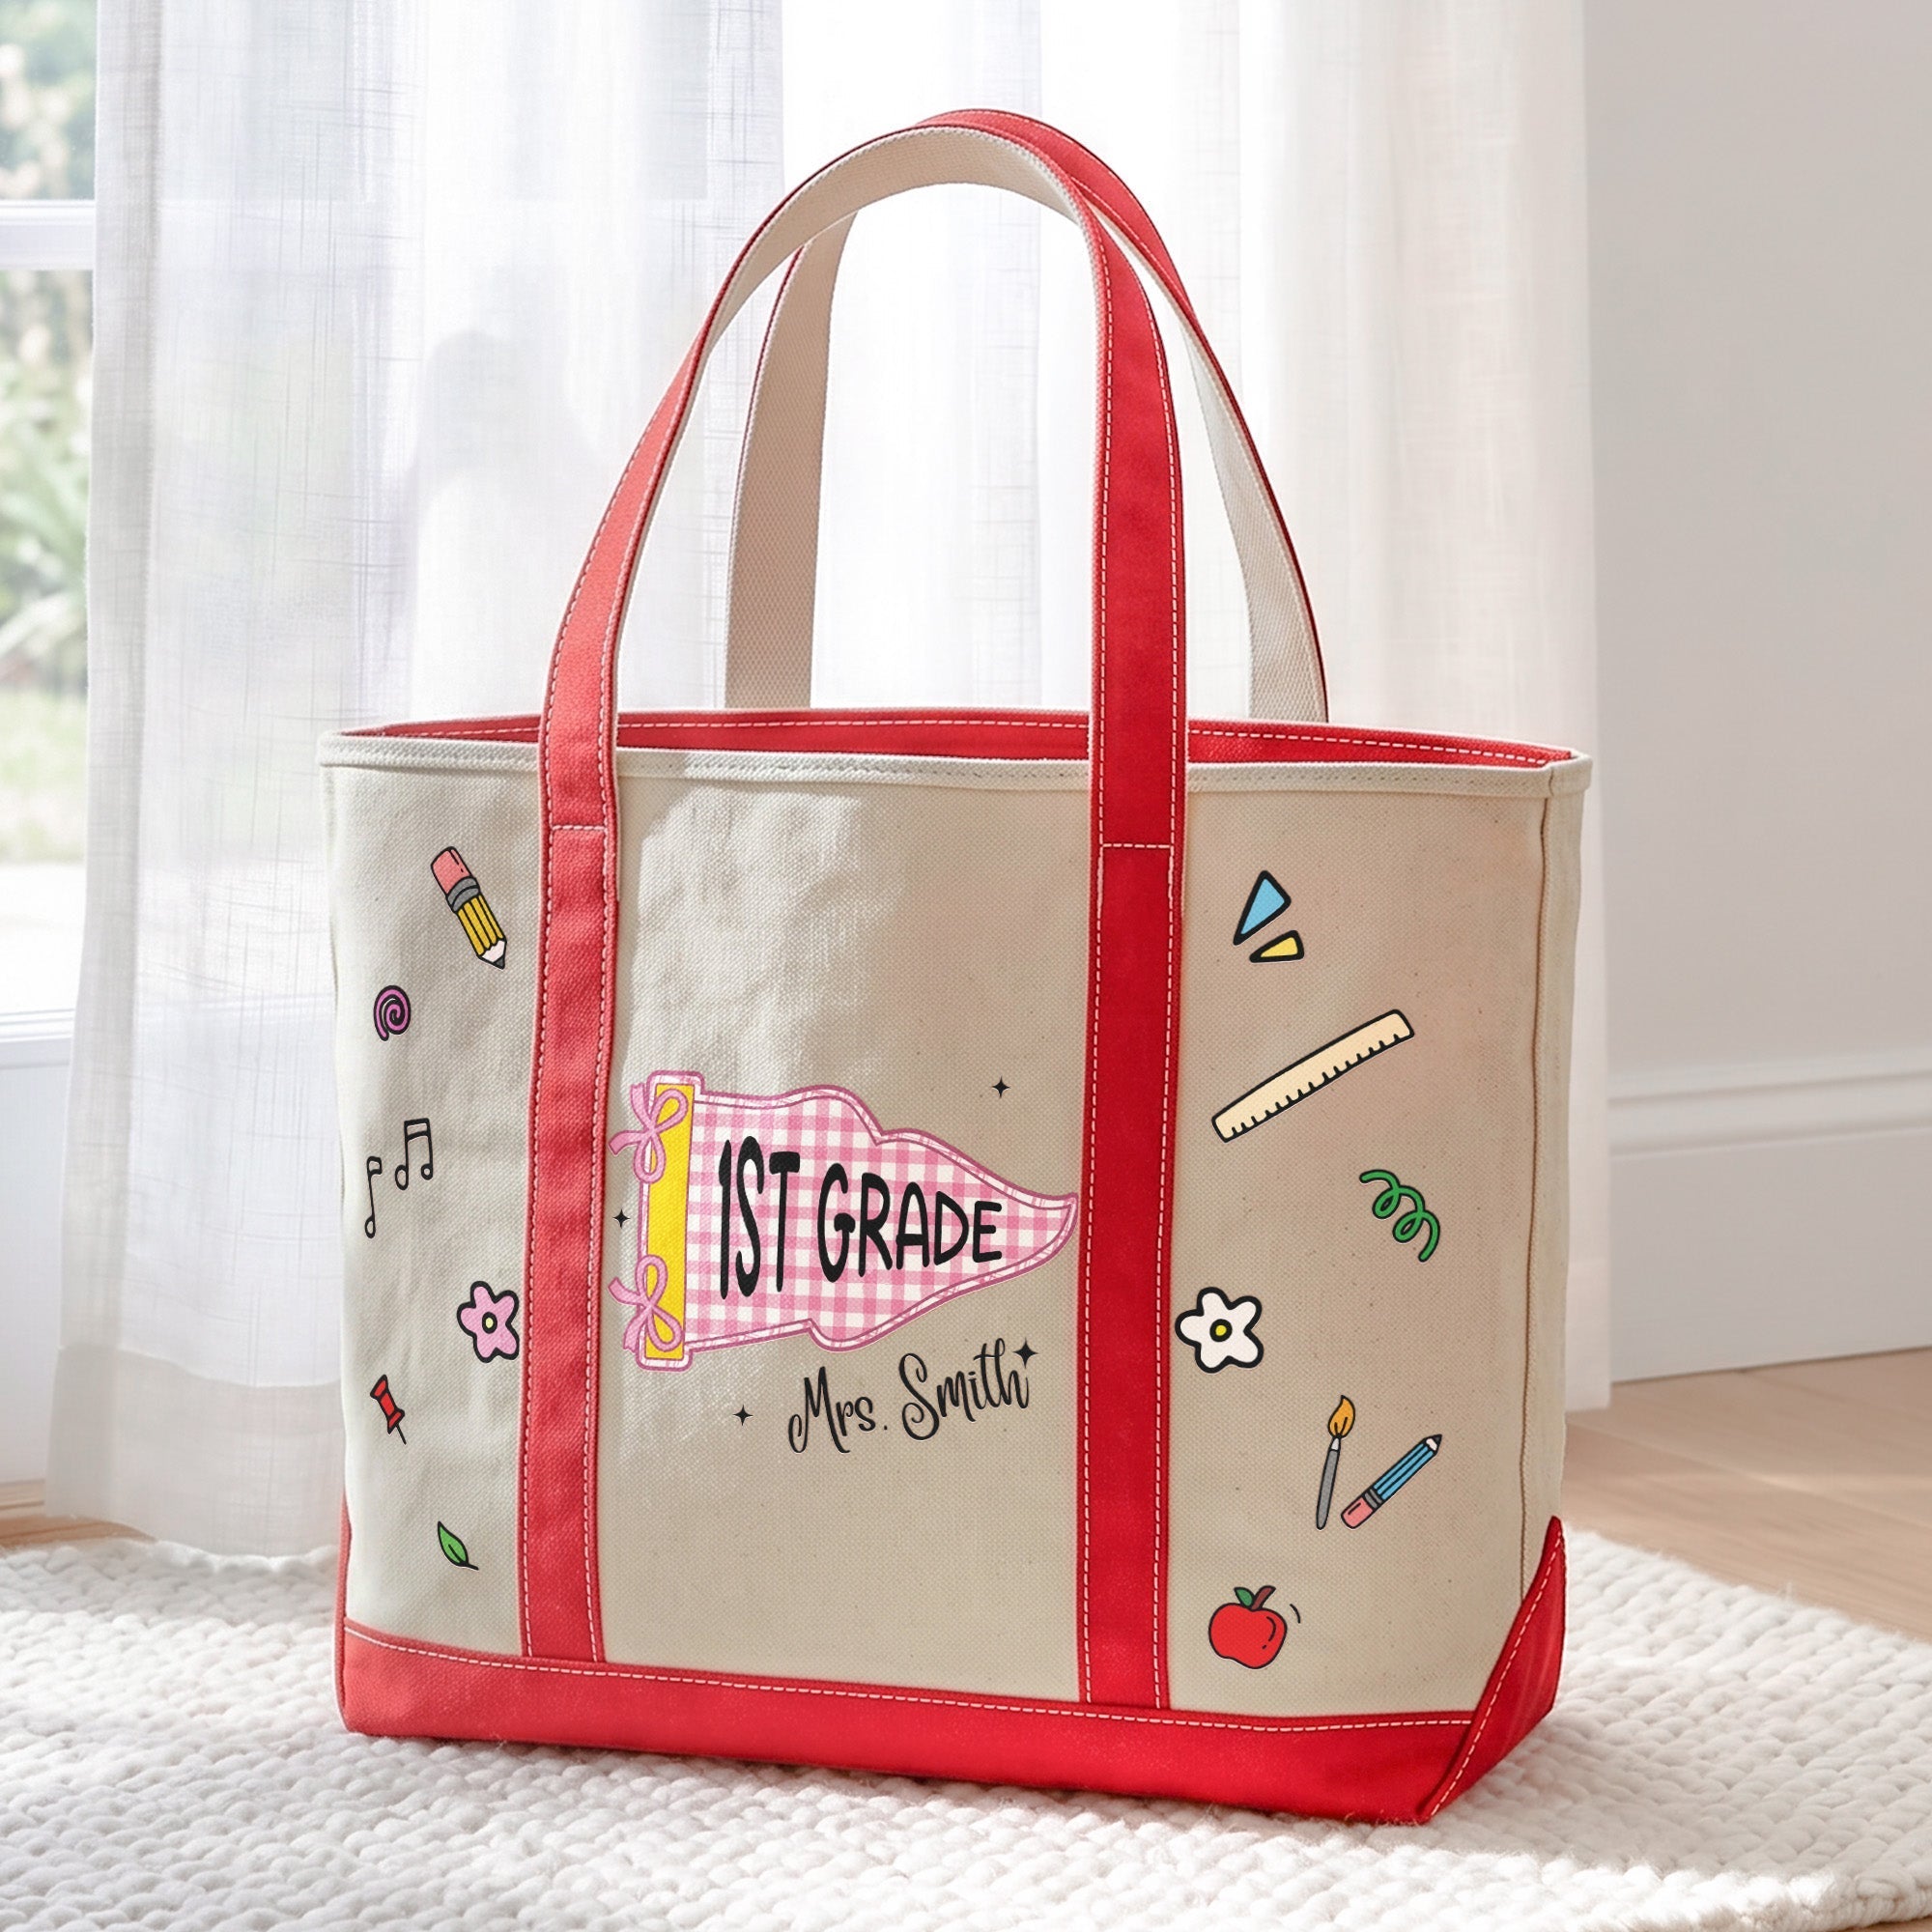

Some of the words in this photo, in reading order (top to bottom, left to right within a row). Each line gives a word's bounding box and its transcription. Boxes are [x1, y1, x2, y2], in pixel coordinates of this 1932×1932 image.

[719, 1135, 801, 1300] 1ST
[817, 1162, 1003, 1283] GRADE
[788, 1366, 889, 1454] Mrs.
[898, 1337, 1030, 1440] Smith
